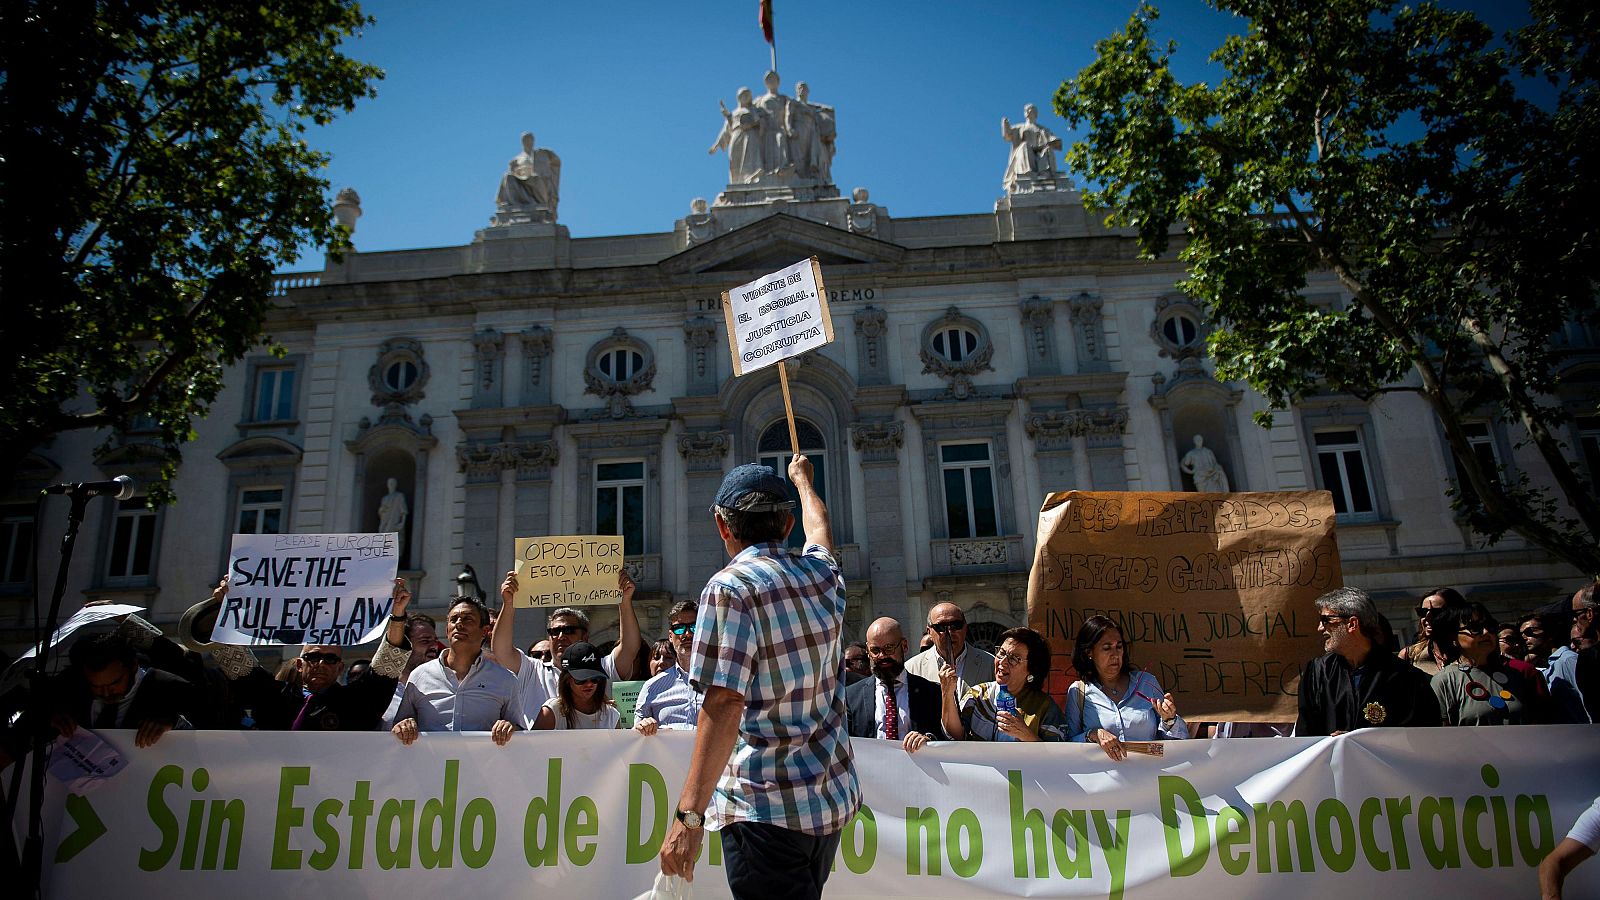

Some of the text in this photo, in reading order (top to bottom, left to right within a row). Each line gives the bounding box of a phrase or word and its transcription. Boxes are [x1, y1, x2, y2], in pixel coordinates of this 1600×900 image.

[742, 272, 802, 302] VIDENTE DE
[829, 288, 875, 302] REMO
[738, 312, 752, 324] EL
[745, 311, 811, 342] JUSTICIA
[744, 327, 820, 362] CORRUPTA
[1048, 498, 1122, 533] ECES
[275, 534, 392, 549] PLEASE EUROPE
[531, 562, 619, 579] ESTO VA POR
[530, 592, 580, 605] MERITO
[307, 629, 364, 645] SPAIN
[1046, 602, 1190, 643] INDNDENCIA
[1160, 661, 1190, 693] DE
[1203, 661, 1301, 696] DEREC
[138, 765, 246, 872] Sin
[271, 759, 497, 872] Estado
[524, 758, 599, 867] de
[905, 806, 984, 878] no
[1008, 770, 1131, 900] hay
[1158, 764, 1556, 878] Democracia
